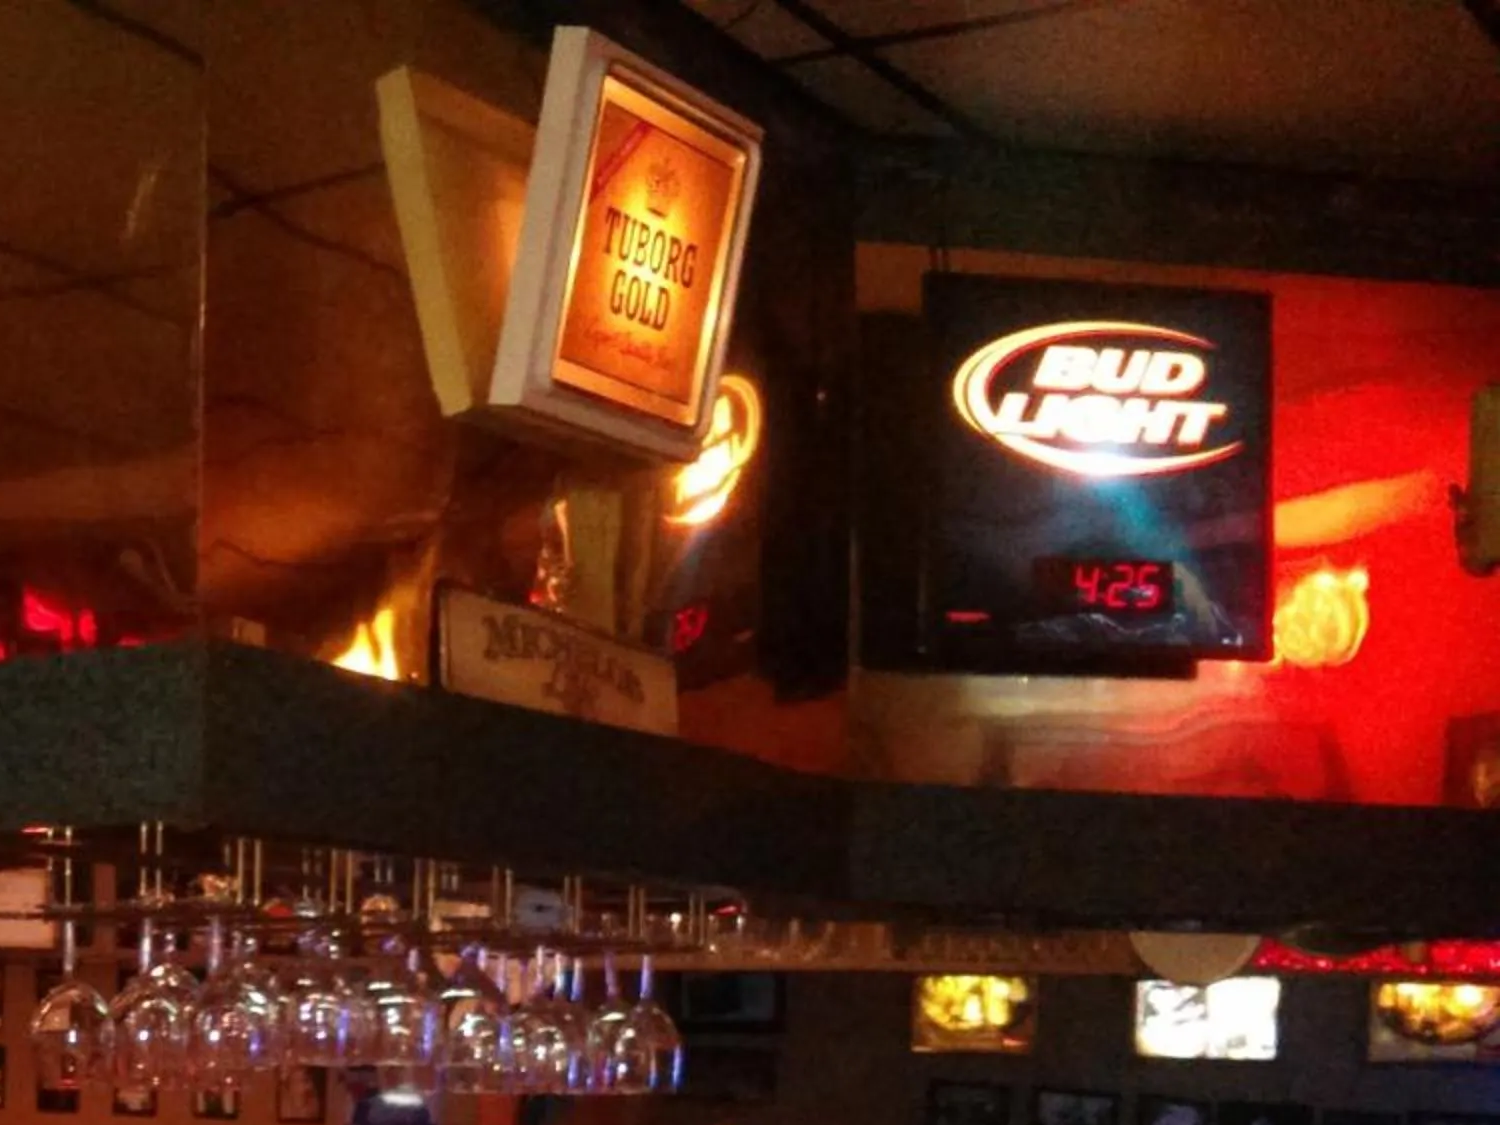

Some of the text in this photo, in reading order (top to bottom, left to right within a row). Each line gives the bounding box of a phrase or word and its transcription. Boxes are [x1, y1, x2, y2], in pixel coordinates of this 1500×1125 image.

[603, 206, 699, 290] TUBORG
[609, 268, 671, 332] GOLD
[1033, 345, 1205, 395] BUD
[992, 393, 1227, 445] LIGHT
